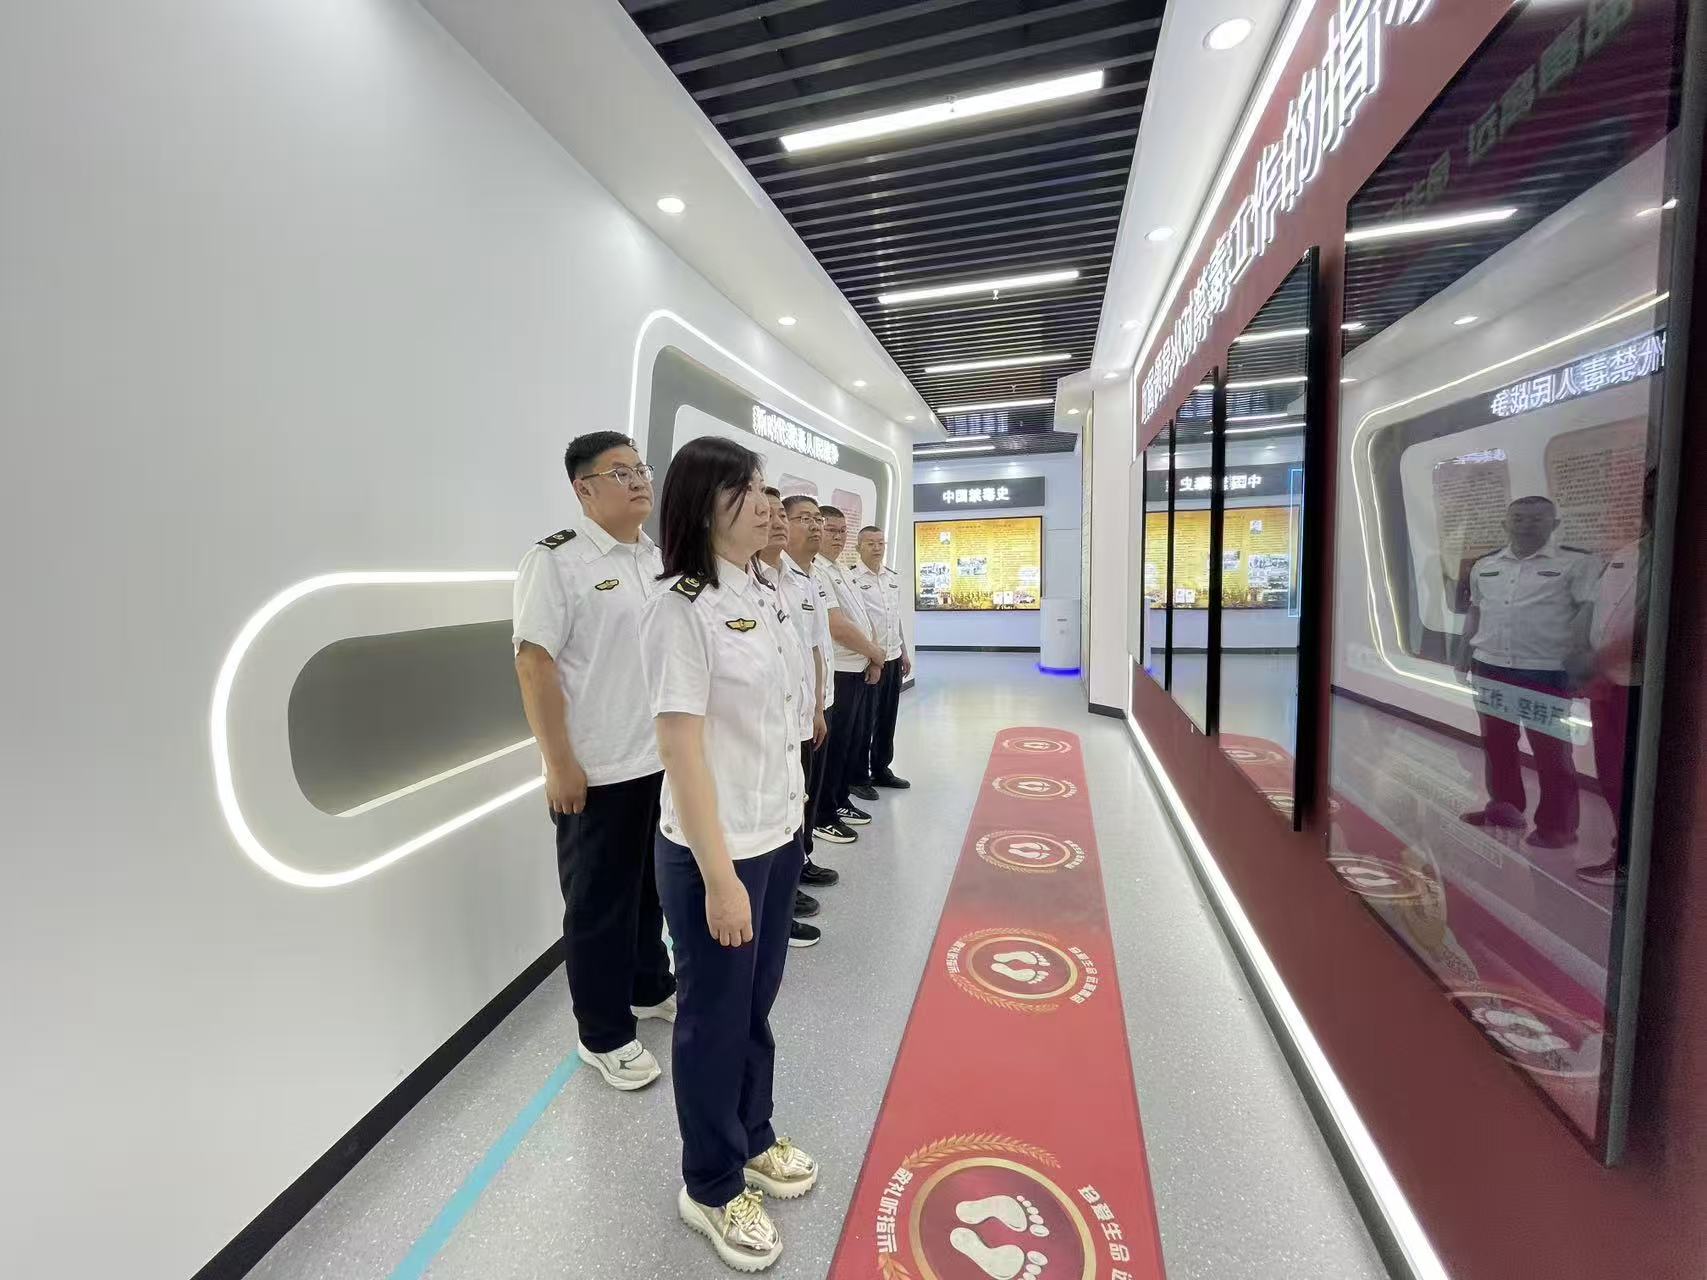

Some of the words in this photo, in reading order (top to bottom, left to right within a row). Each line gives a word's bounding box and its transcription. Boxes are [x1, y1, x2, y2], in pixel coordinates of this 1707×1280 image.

[876, 1167, 913, 1253] 敬礼听指示
